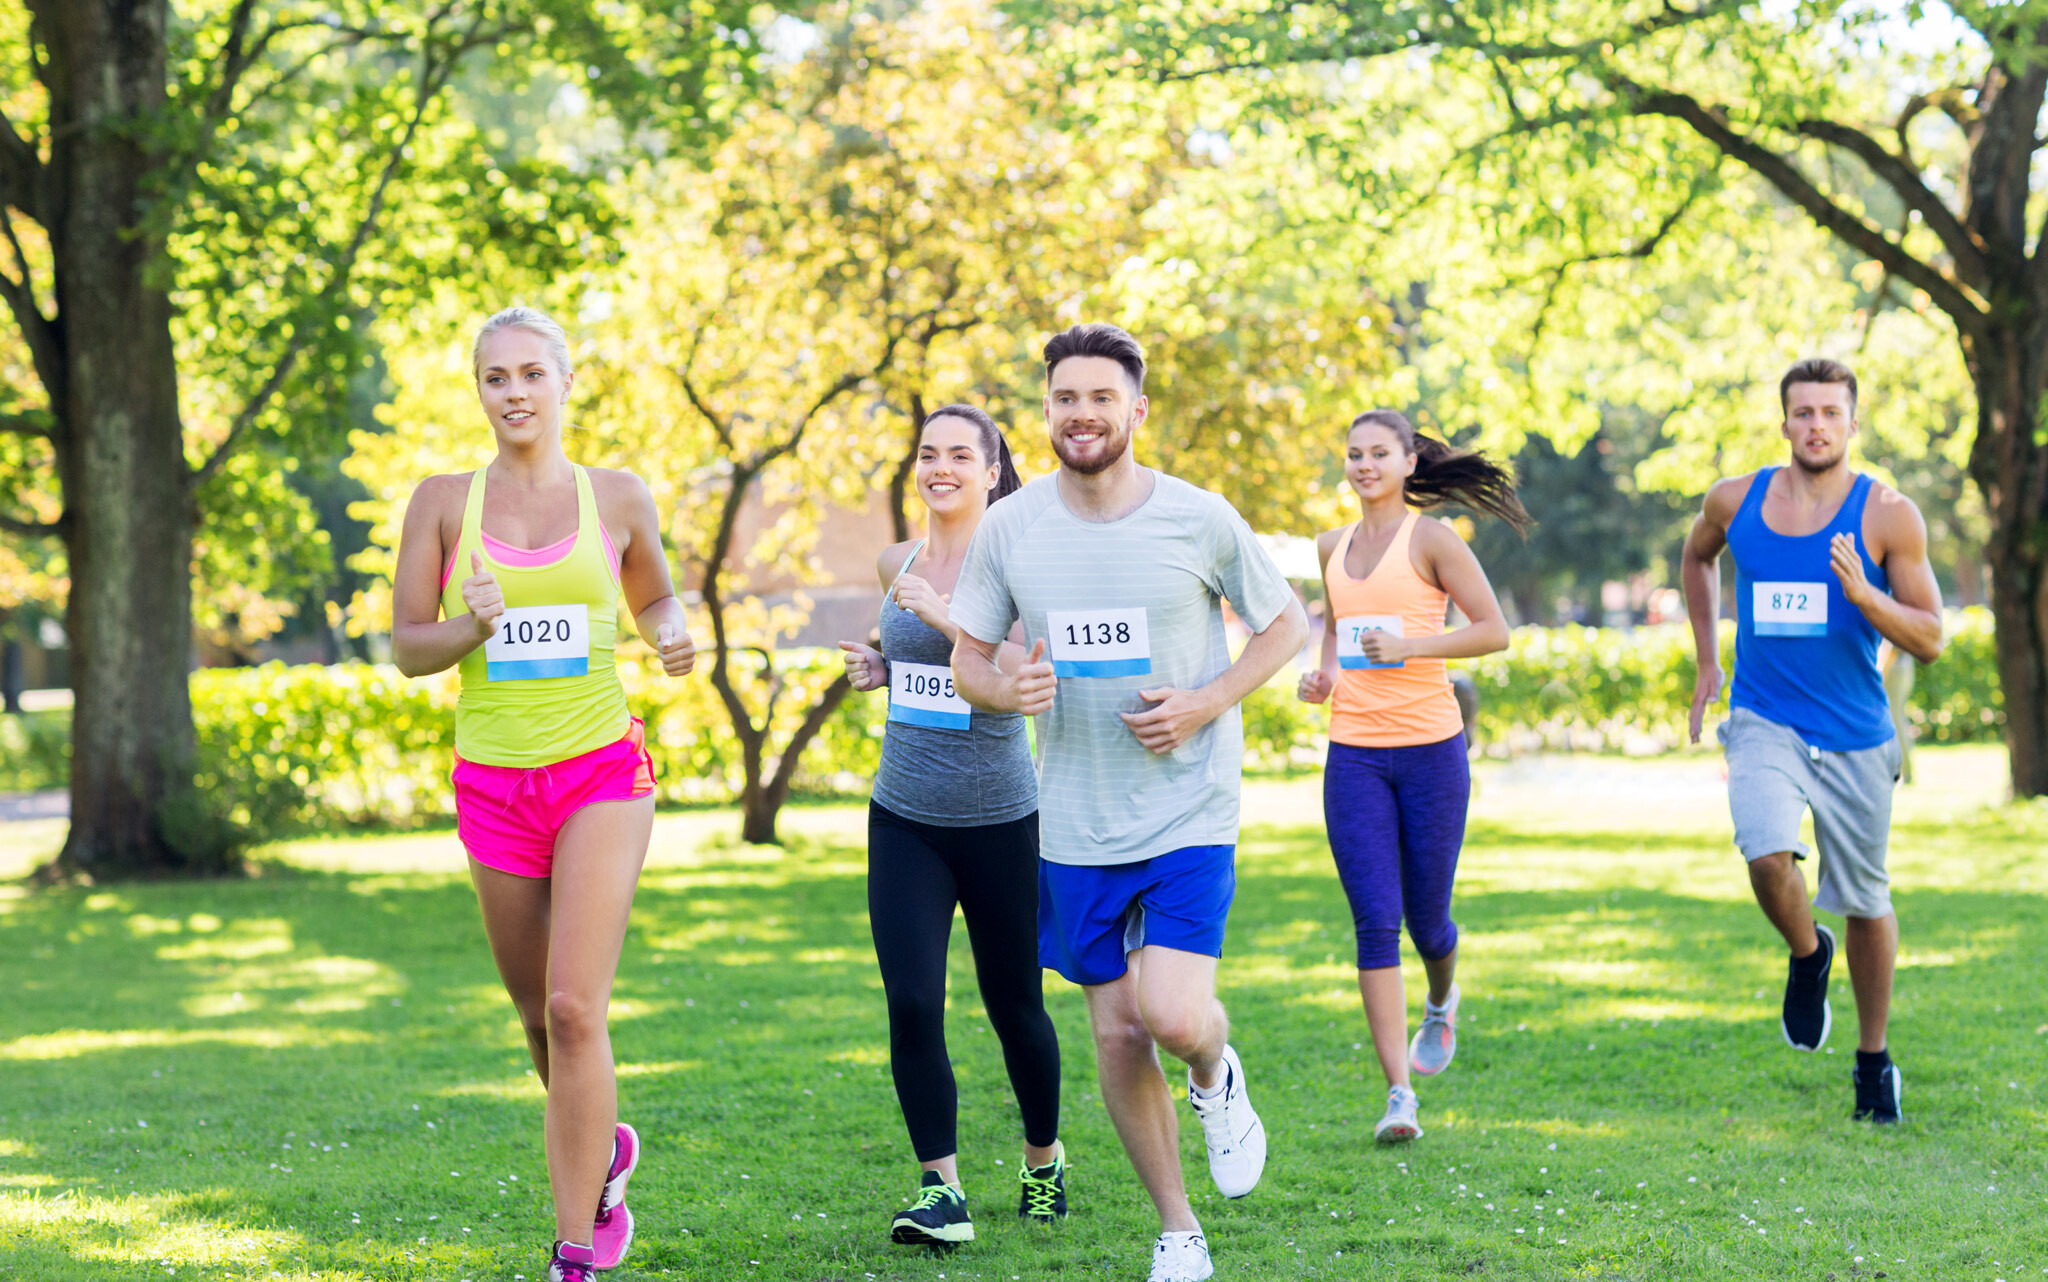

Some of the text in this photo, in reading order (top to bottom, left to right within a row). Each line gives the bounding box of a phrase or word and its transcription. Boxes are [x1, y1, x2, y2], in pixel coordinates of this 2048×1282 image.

[1772, 593, 1808, 610] 872
[503, 619, 571, 645] 1020
[1066, 622, 1131, 645] 1138
[905, 673, 956, 698] 1095
